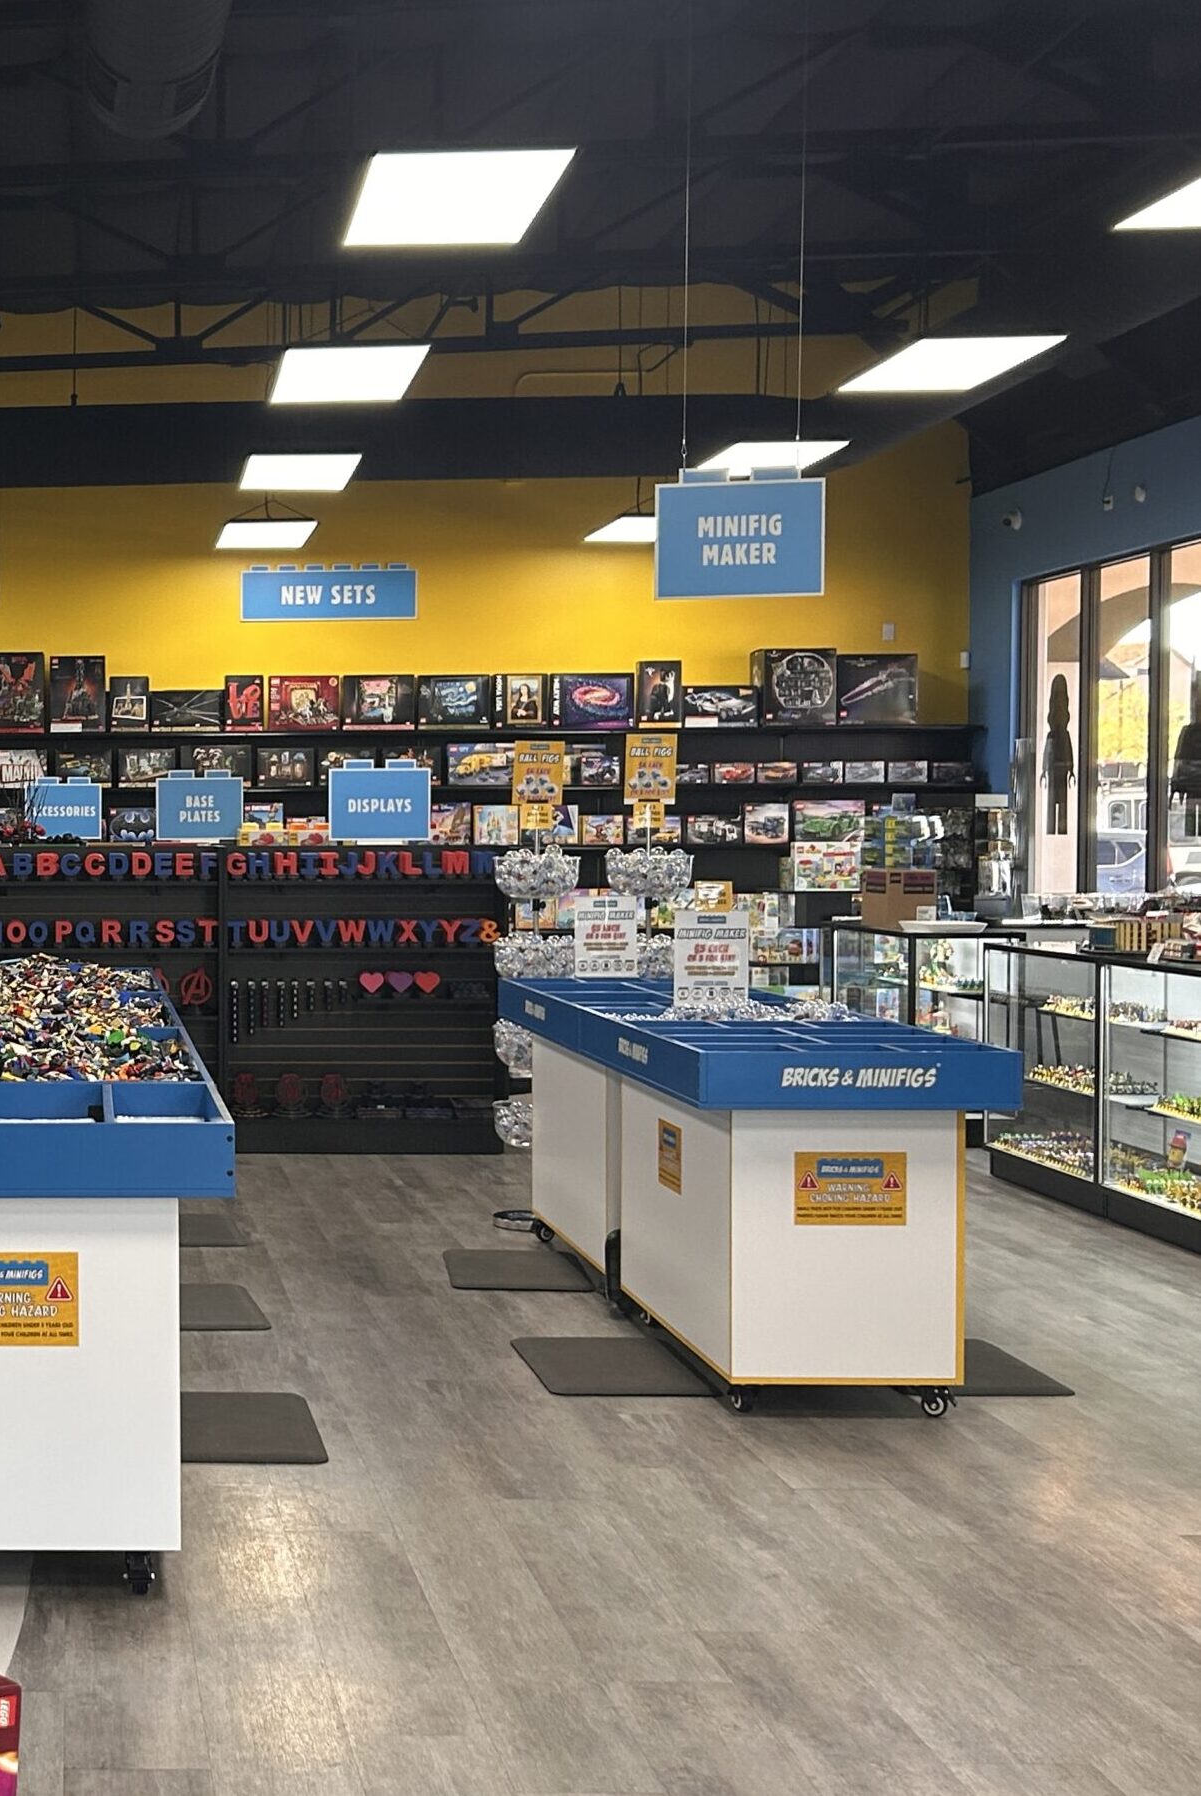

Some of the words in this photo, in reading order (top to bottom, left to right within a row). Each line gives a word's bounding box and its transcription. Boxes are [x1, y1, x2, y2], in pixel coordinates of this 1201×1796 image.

[698, 514, 782, 538] MINIFIG
[702, 542, 776, 566] MAKER
[280, 585, 322, 605] NEW
[331, 585, 376, 605] SETS
[186, 795, 215, 808] BASE
[348, 799, 412, 813] DISPLAYS
[179, 810, 221, 823] PLATES
[781, 1067, 840, 1087] BRICKS
[841, 1069, 853, 1086] &
[855, 1067, 937, 1088] MINIFIGS
[827, 1183, 870, 1192] WARNING
[810, 1193, 849, 1202] CHOKING
[853, 1193, 891, 1202] HAZARD
[5, 1269, 43, 1280] MINIFIGS
[11, 1305, 58, 1317] HAZARD
